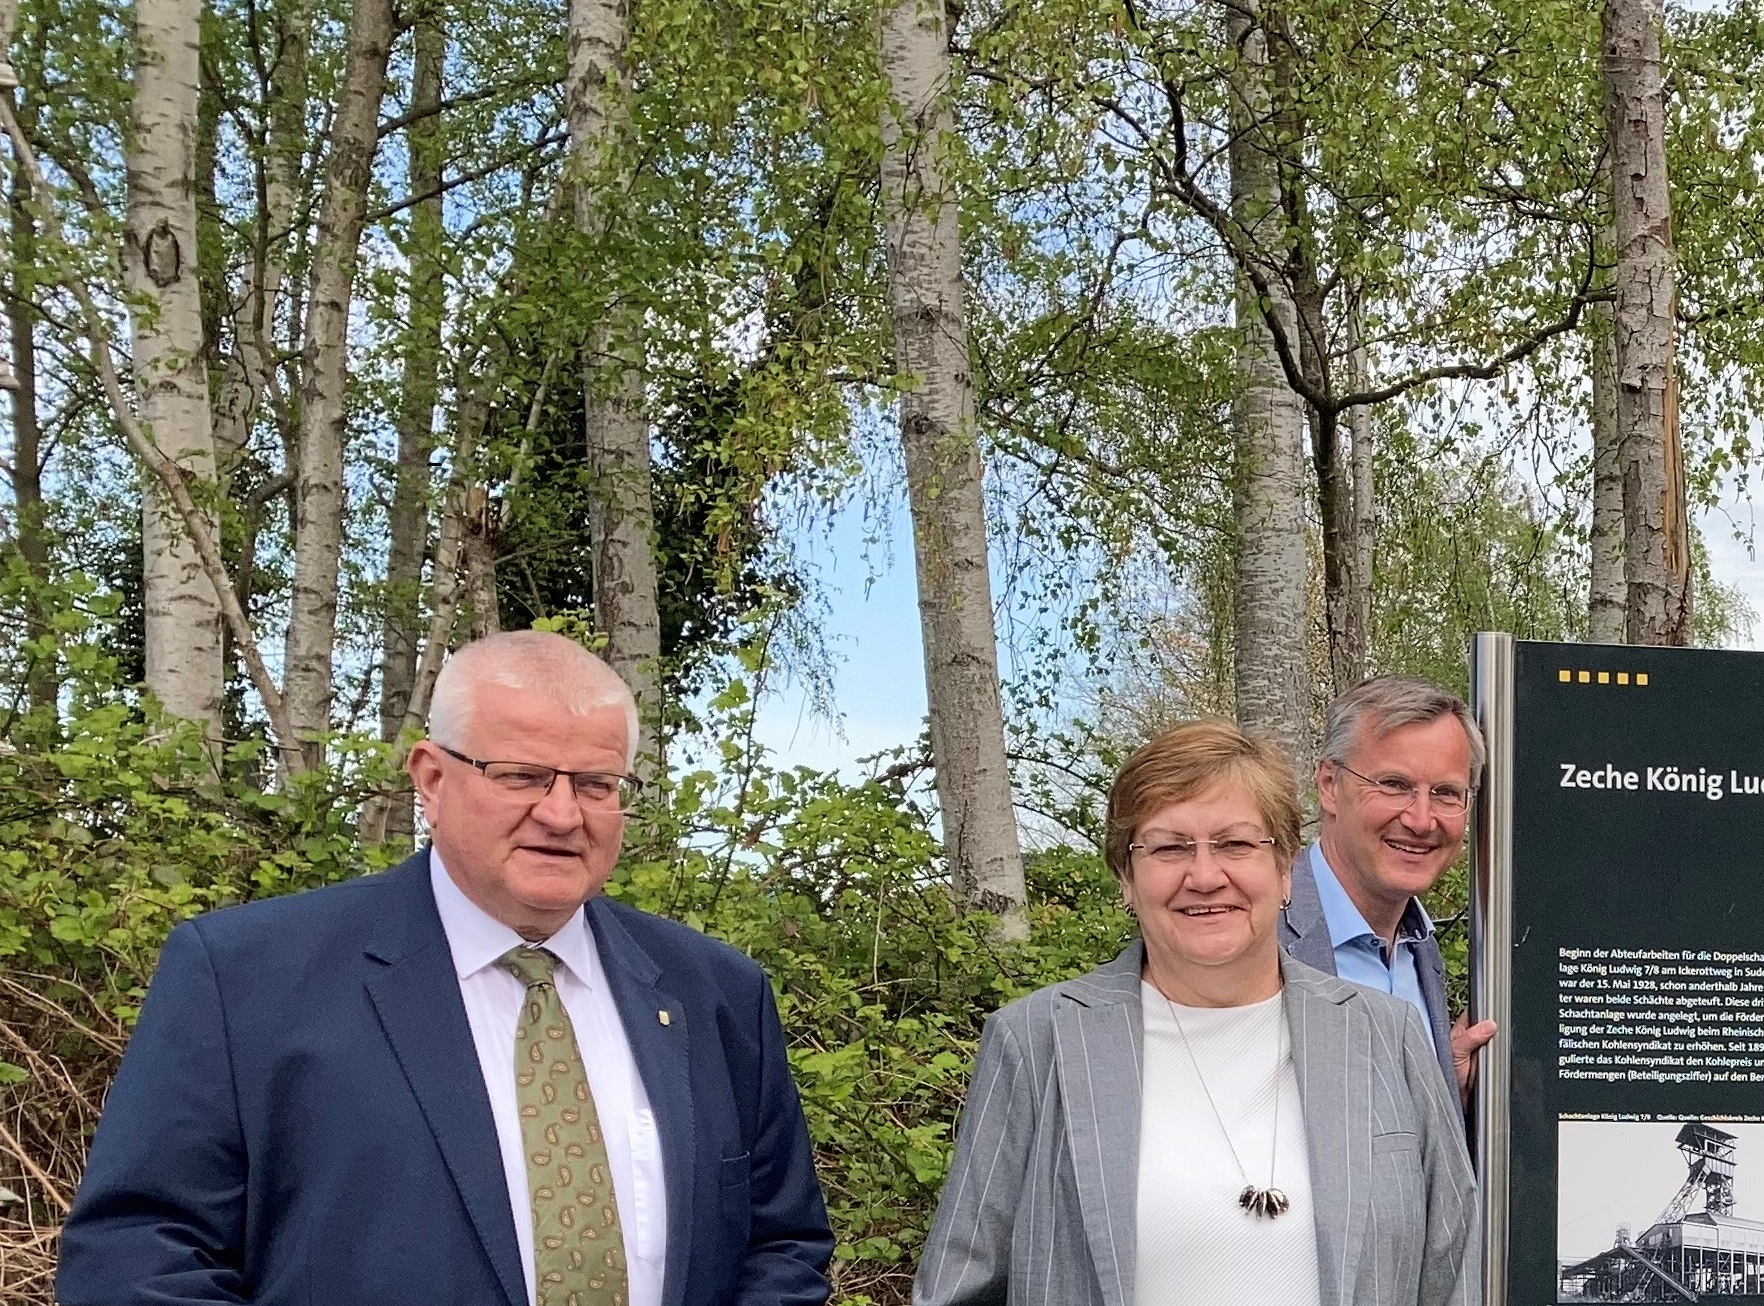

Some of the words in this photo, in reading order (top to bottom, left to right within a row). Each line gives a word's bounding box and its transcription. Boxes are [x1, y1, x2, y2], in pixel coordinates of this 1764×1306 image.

[1560, 763, 1638, 790] Zeche
[1647, 766, 1723, 801] König
[1559, 948, 1591, 961] Beginn
[1593, 949, 1609, 958] der
[1610, 949, 1680, 960] Abteufarbeiten
[1682, 950, 1696, 961] für
[1697, 951, 1712, 961] die
[1559, 963, 1579, 975] lage
[1581, 964, 1607, 976] König
[1609, 964, 1642, 977] Ludwig
[1644, 965, 1660, 976] 7/8
[1678, 966, 1733, 979] Ickerottweg
[1734, 967, 1743, 977] in
[1579, 979, 1595, 989] der
[1597, 980, 1611, 989] 15.
[1613, 980, 1631, 989] Mai
[1633, 980, 1658, 991] 1928,
[1660, 981, 1687, 991] schon
[1688, 981, 1738, 992] anderthalb
[1740, 982, 1764, 992] Jahre
[1559, 994, 1573, 1004] ter
[1574, 996, 1604, 1004] waren
[1606, 994, 1632, 1005] beide
[1633, 995, 1674, 1006] Schächte
[1675, 996, 1724, 1009] abgeteuft.
[1725, 997, 1750, 1007] Diese
[1559, 1009, 1625, 1022] Schachtanlage
[1627, 1010, 1656, 1020] wurde
[1658, 1011, 1701, 1024] angelegt,
[1719, 1012, 1734, 1022] die
[1559, 1024, 1588, 1036] ligung
[1589, 1024, 1605, 1034] der
[1606, 1025, 1634, 1035] Zeche
[1635, 1025, 1662, 1038] König
[1663, 1026, 1696, 1038] Ludwig
[1697, 1026, 1720, 1036] beim
[1558, 1039, 1600, 1049] fälischen
[1602, 1040, 1672, 1052] Kohlensyndikat
[1674, 1043, 1684, 1051] zu
[1686, 1042, 1726, 1052] erhöhen.
[1728, 1042, 1746, 1052] Seit
[1558, 1054, 1594, 1067] gulierte
[1596, 1055, 1612, 1064] das
[1615, 1055, 1684, 1068] Kohlensyndikat
[1686, 1056, 1704, 1066] den
[1705, 1057, 1752, 1069] Kohlepreis
[1559, 1069, 1626, 1082] Fördermengen
[1628, 1070, 1712, 1084] (Beteiligungsziffer)
[1713, 1072, 1729, 1081] auf
[1730, 1072, 1748, 1082] den
